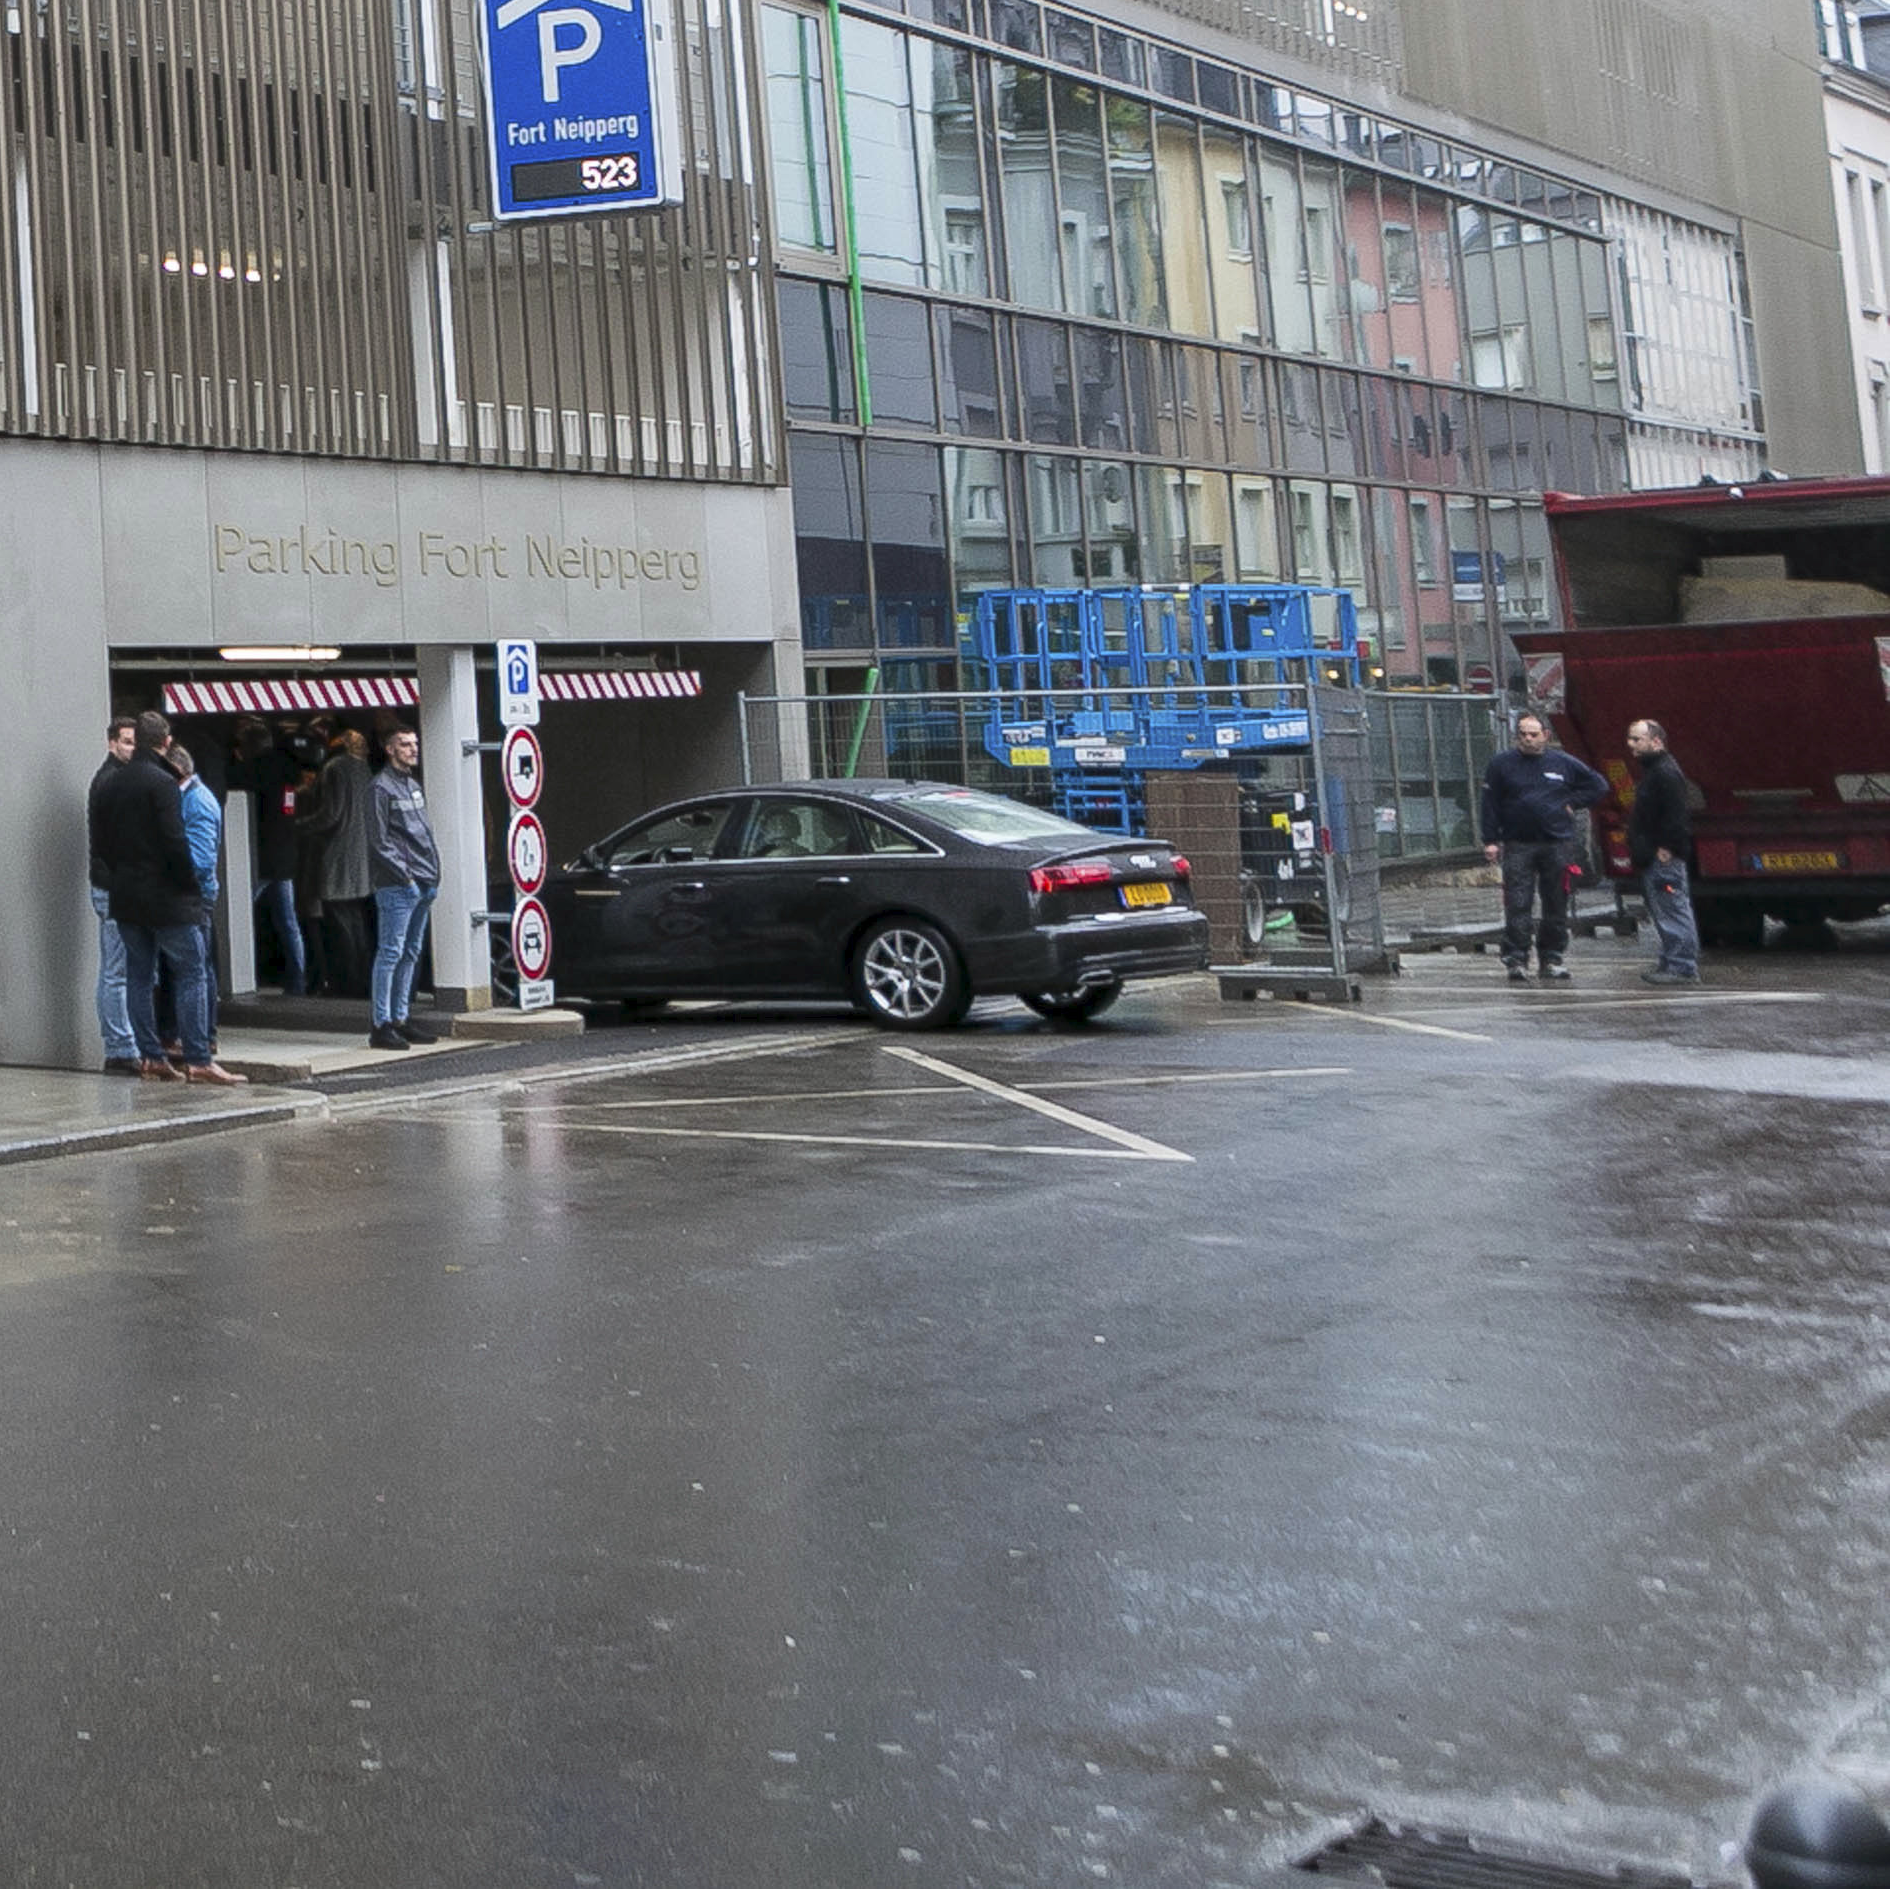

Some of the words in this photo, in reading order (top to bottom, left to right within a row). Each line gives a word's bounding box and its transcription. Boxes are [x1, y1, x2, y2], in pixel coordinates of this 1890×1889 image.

[537, 8, 603, 103] P
[507, 119, 547, 147] Fort
[553, 114, 639, 144] Neipperg
[580, 156, 638, 190] 523
[214, 523, 399, 588] Parking
[418, 530, 509, 579] Fort
[525, 533, 700, 591] Neipperg
